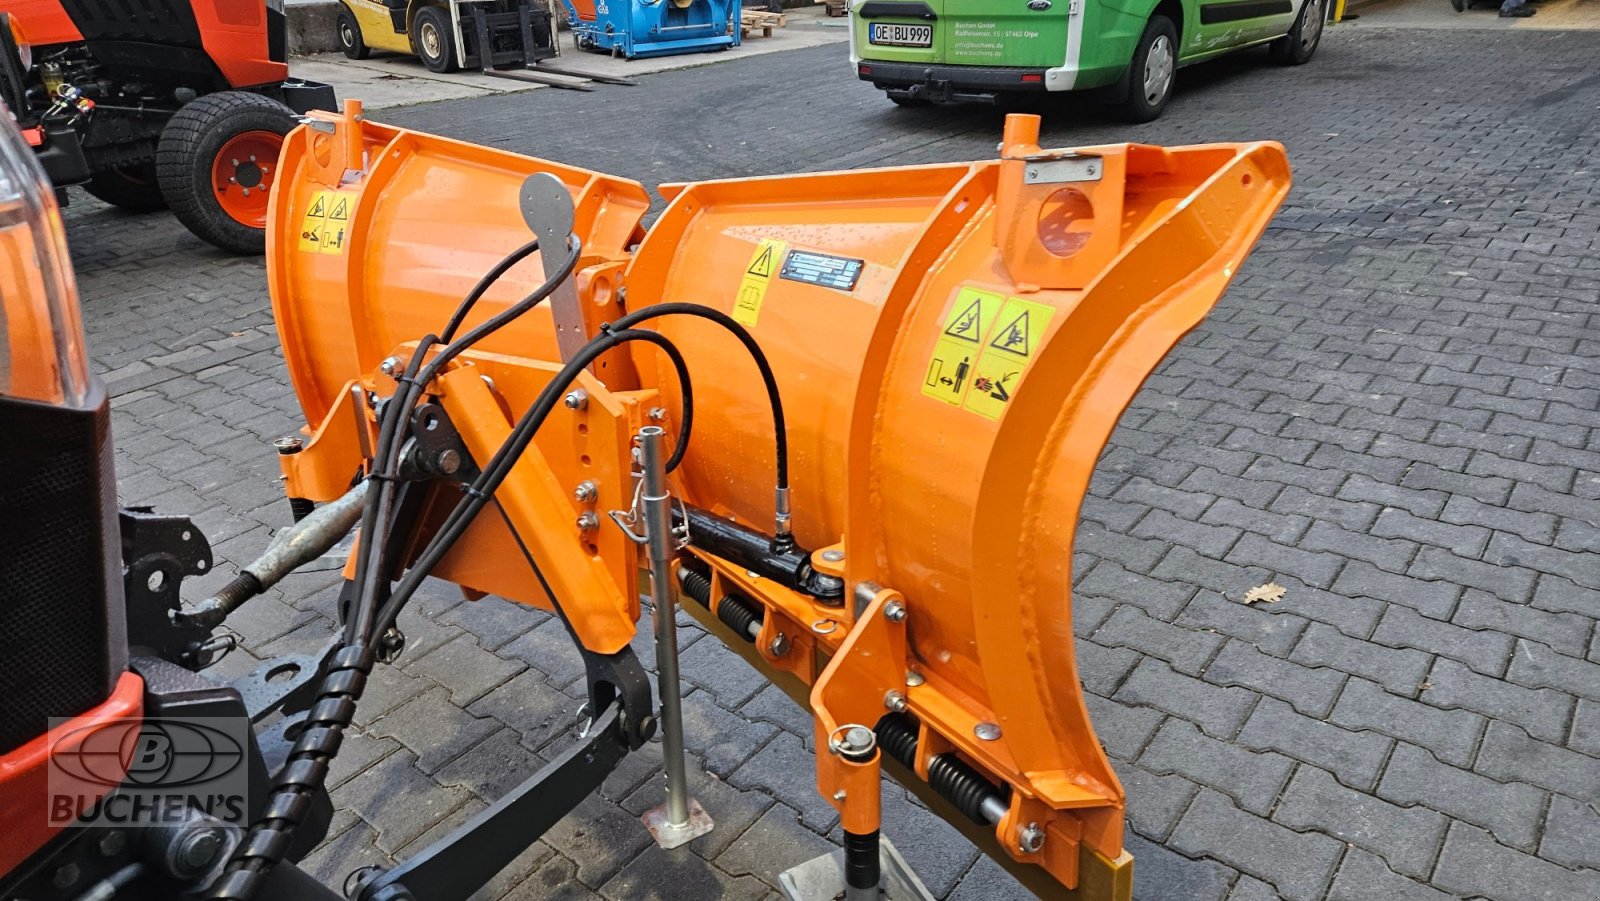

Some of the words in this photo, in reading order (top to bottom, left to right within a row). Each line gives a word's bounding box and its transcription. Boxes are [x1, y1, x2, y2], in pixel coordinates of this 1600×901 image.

[876, 26, 889, 40] OE
[894, 26, 908, 40] BU
[909, 27, 930, 42] 999
[1024, 31, 1039, 39] Olpe
